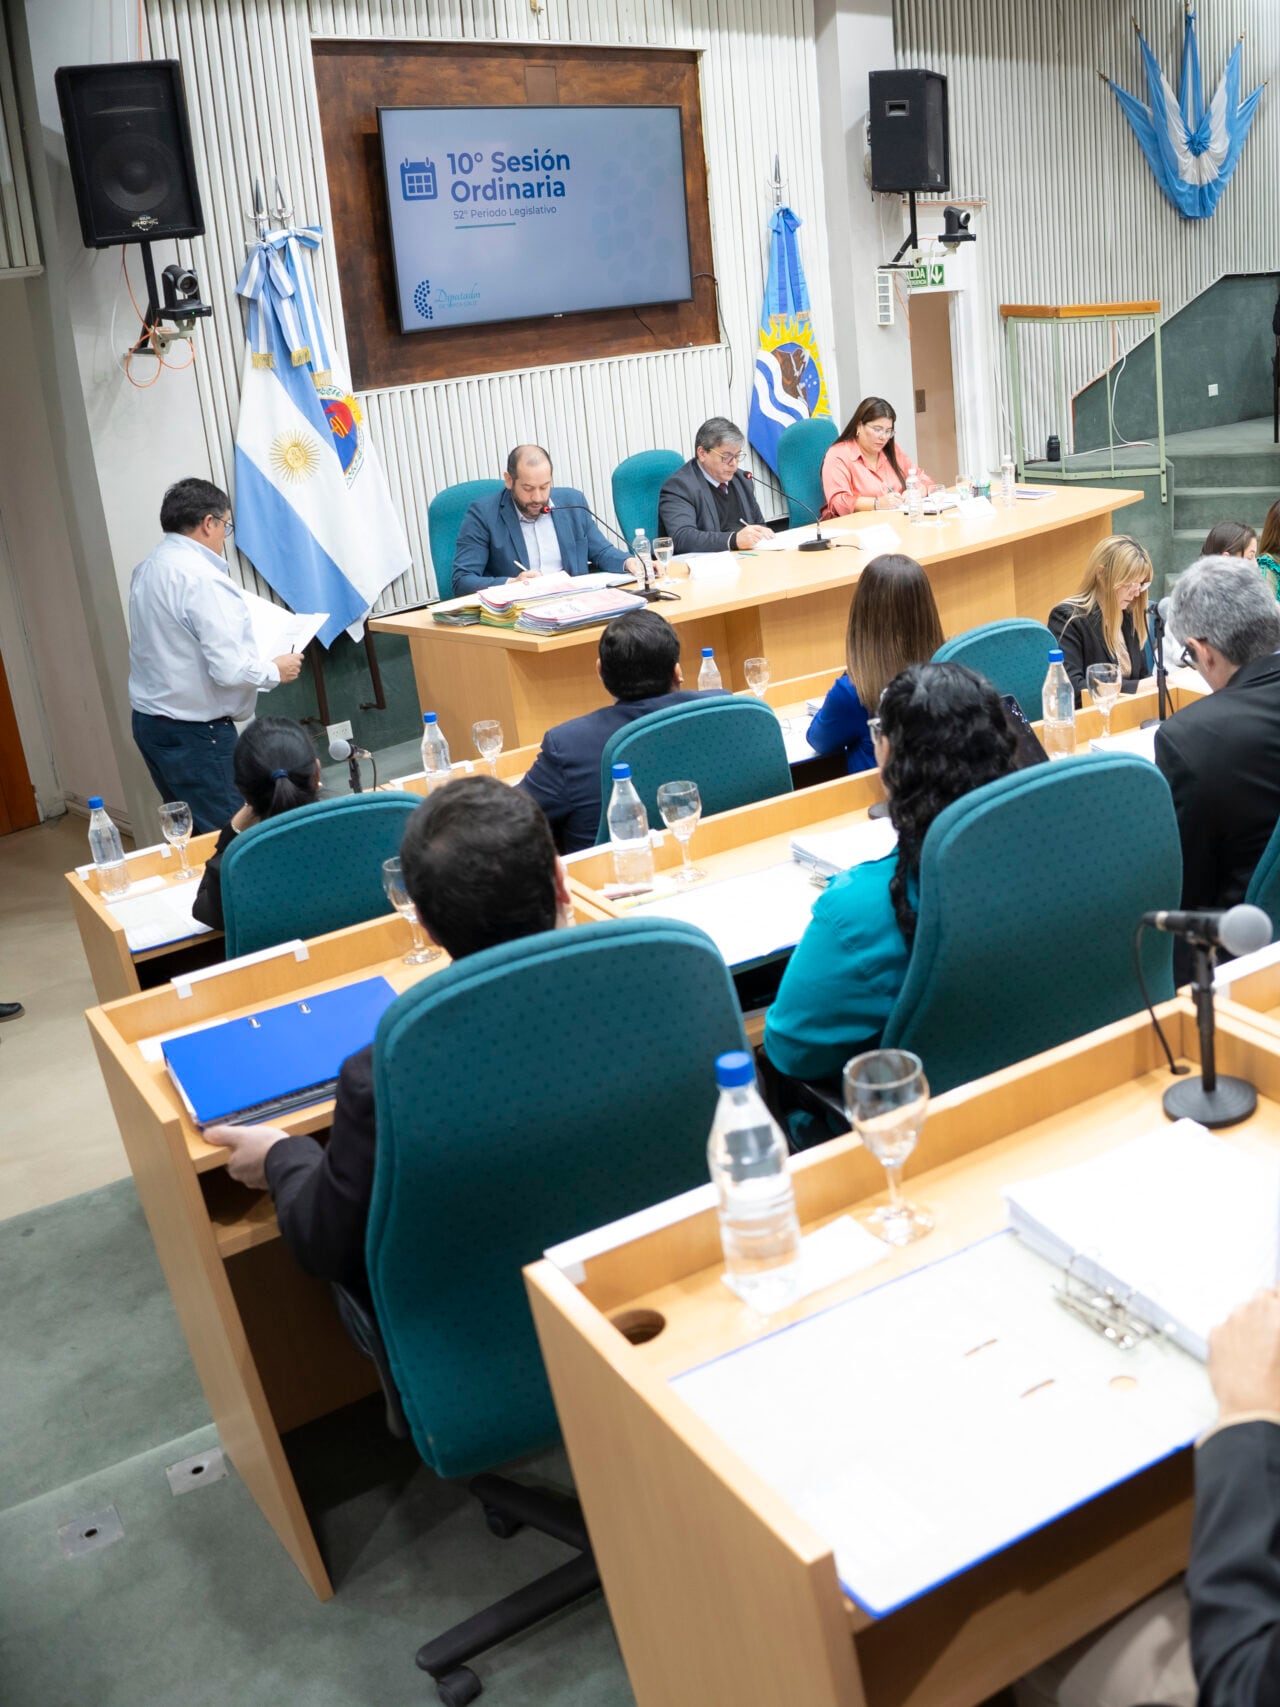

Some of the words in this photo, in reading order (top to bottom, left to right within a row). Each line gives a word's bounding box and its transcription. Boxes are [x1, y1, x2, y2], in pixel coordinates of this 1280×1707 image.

[491, 148, 570, 173] Sesión
[451, 175, 566, 203] Ordinaria
[509, 205, 557, 218] Legislativo
